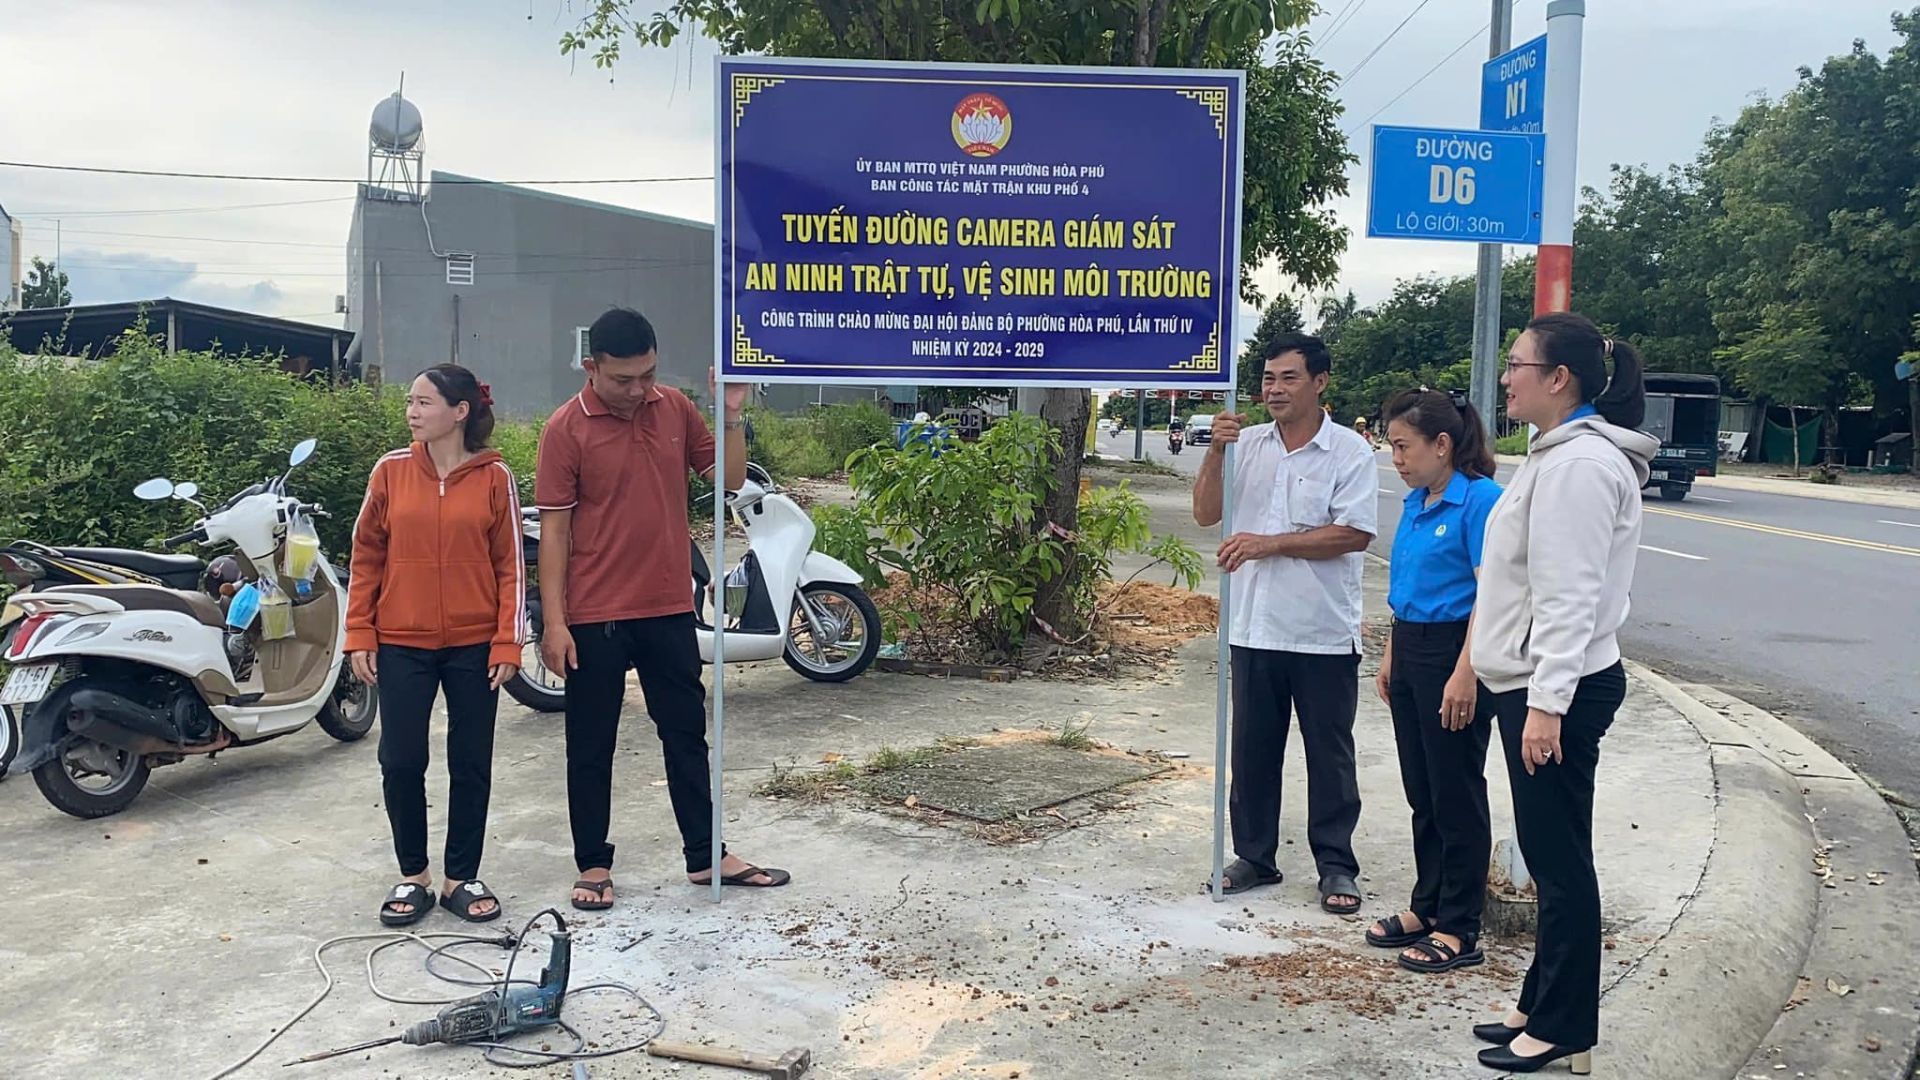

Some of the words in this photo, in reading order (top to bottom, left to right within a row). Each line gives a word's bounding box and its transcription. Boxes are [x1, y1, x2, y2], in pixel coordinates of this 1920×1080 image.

[1500, 49, 1536, 81] ĐƯỜNG
[1505, 77, 1527, 120] N1
[1416, 135, 1493, 161] ĐƯỜNG
[856, 157, 872, 172] ỦY
[875, 161, 901, 173] BAN
[904, 162, 937, 176] MTTQ
[940, 161, 966, 177] VIỆT
[968, 164, 997, 176] NAM
[1000, 163, 1050, 177] PHƯỜNG
[871, 180, 897, 191] BAN
[900, 178, 933, 192] CÔNG
[936, 180, 960, 193] TÁC
[962, 180, 989, 195] MẶT
[992, 180, 1024, 196] TRẬN
[1026, 183, 1051, 195] KHU
[1054, 181, 1079, 196] PHỐ
[1081, 184, 1089, 196] 4
[1429, 164, 1476, 205] D6
[782, 205, 858, 243] TUYẾN
[866, 210, 948, 246] ĐƯỜNG
[956, 217, 1056, 248] CAMERA
[1064, 214, 1124, 249] GIÁM
[1132, 215, 1176, 249] SÁT
[1467, 216, 1505, 234] 30m
[744, 262, 777, 291] AN
[785, 263, 843, 293] NINH
[851, 259, 911, 300] TRẬT
[917, 263, 955, 301] TỰ,
[962, 260, 992, 301] VỆ
[1000, 267, 1055, 296] SINH
[1064, 263, 1109, 297] MÔI
[1117, 264, 1211, 299] TRƯỜNG
[761, 308, 795, 328] CÔNG
[798, 309, 834, 329] TRÌNH
[838, 309, 871, 330] CHÀO
[874, 310, 910, 330] MỪNG
[913, 314, 934, 334] ĐẠI
[937, 312, 958, 335] HỘI
[961, 311, 993, 331] ĐẢNG
[996, 312, 1014, 335] BỘ
[1017, 313, 1066, 333] PHƯỜNG
[1069, 315, 1094, 333] HÒA
[1096, 314, 1125, 336] PHÚ,
[1128, 312, 1151, 334] LẦN
[1154, 315, 1179, 334] THỨ
[1180, 318, 1194, 334] IV
[912, 337, 951, 359] NHIỆM
[954, 338, 970, 357] KỲ
[972, 341, 1003, 357] 2024
[1014, 342, 1045, 358] 2029
